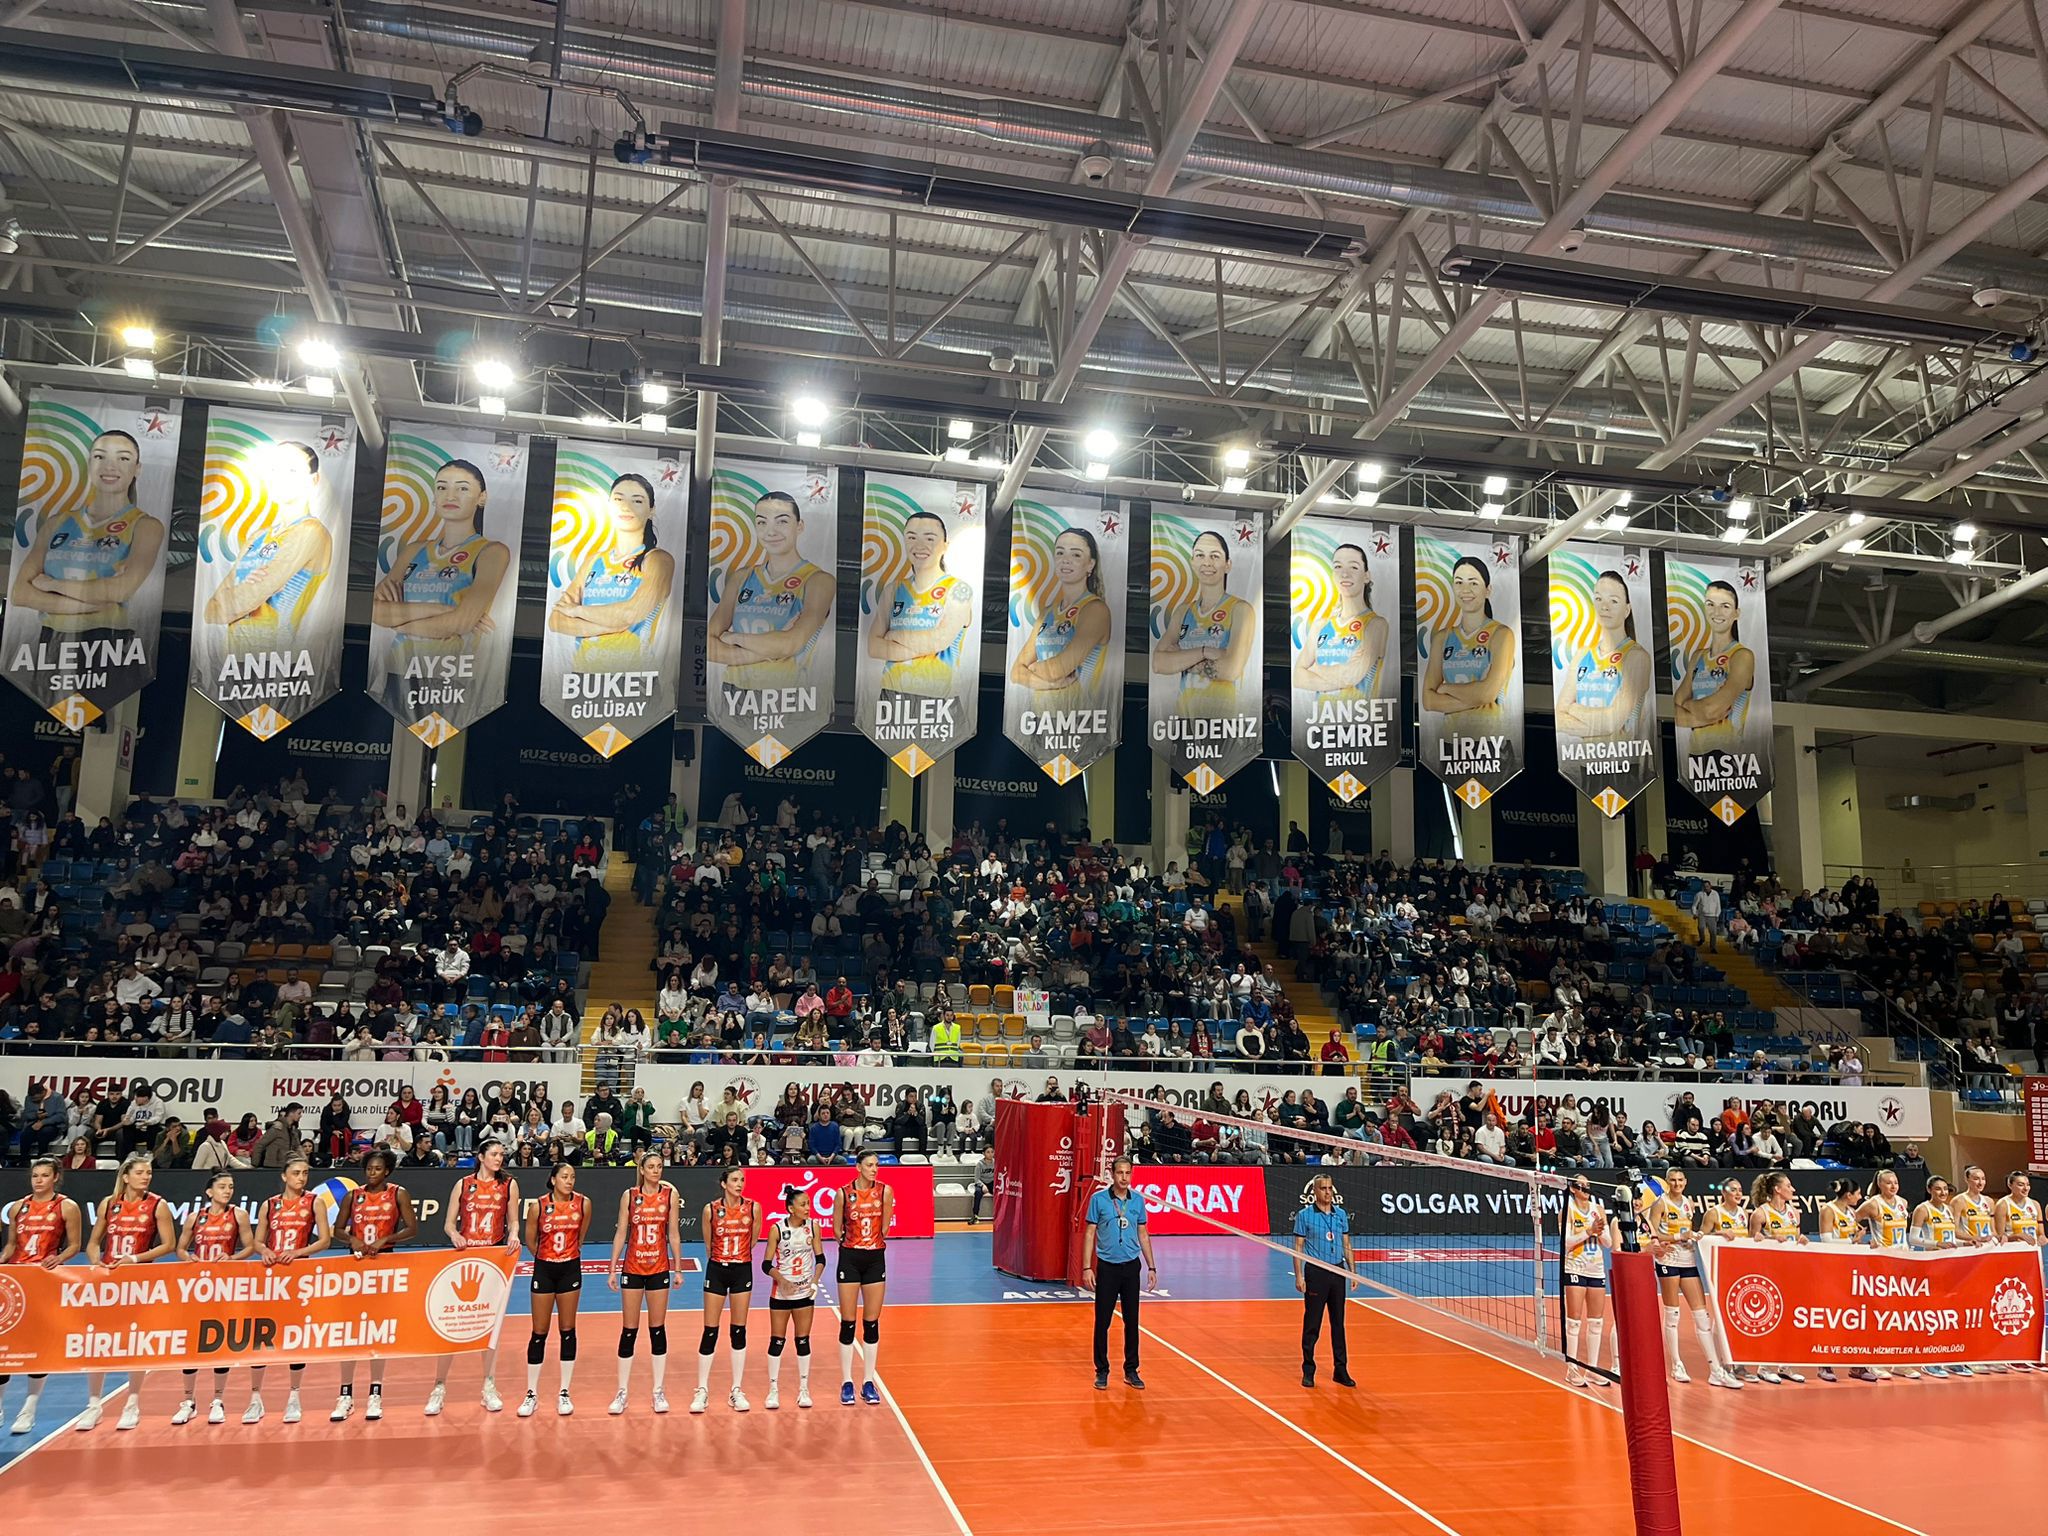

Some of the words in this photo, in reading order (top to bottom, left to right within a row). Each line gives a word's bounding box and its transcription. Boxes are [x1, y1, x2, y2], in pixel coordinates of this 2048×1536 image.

[10, 638, 146, 672] ALEYNA
[218, 650, 315, 682] ANNA
[404, 654, 474, 684] AYŞE
[50, 672, 107, 691] SEVİM
[219, 681, 312, 701] LAZAREVA
[561, 671, 659, 699] BUKET
[407, 687, 464, 709] ÇÜRÜK
[723, 687, 817, 716] YAREN
[65, 694, 85, 730] 5
[571, 701, 647, 719] GÜLÜBAY
[875, 695, 955, 725] DİLEK
[1305, 698, 1397, 725] JANSET
[418, 717, 448, 747] 21
[753, 715, 784, 733] IŞIK
[875, 725, 916, 739] KINIK
[921, 722, 953, 742] EKŞİ
[1020, 710, 1107, 735] GAMZE
[1153, 713, 1257, 741] GÜLDENİZ
[122, 730, 131, 756] B
[287, 738, 392, 755] KUZEYBORU
[599, 726, 615, 757] 7
[1045, 735, 1081, 752] KILIÇ
[1306, 723, 1387, 749] CEMRE
[1439, 732, 1504, 761] LİRAY
[757, 737, 782, 763] 16
[1186, 743, 1223, 759] ÖNAL
[1325, 751, 1368, 767] ERKUL
[1561, 739, 1653, 761] MARGARITA
[744, 764, 836, 781] KUZEYBORU
[906, 747, 917, 776] 1
[1049, 759, 1072, 784] 11
[1445, 760, 1500, 775] AKPINAR
[1586, 760, 1630, 776] KURILO
[1689, 753, 1761, 780] NASYA
[1194, 766, 1215, 794] 10
[1337, 773, 1358, 800] 13
[1694, 776, 1758, 793] DIMITROVA
[1467, 781, 1481, 806] 8
[1601, 789, 1619, 816] 17
[1500, 810, 1576, 824] KUZEYBORU
[1721, 802, 1734, 826] 6
[272, 1078, 404, 1099] KUZEYBORU
[1131, 1184, 1245, 1213] SARAY
[1381, 1193, 1480, 1215] SOLGAR
[470, 1211, 494, 1233] 14
[860, 1217, 872, 1237] 3
[1976, 1222, 1990, 1238] 14
[24, 1234, 39, 1256] 4
[275, 1228, 298, 1251] 12
[363, 1223, 378, 1245] 8
[553, 1232, 565, 1253] 9
[637, 1224, 659, 1245] 15
[1892, 1228, 1904, 1244] 17
[111, 1234, 135, 1259] 16
[722, 1236, 740, 1257] 11
[791, 1257, 803, 1276] 2
[1661, 1265, 1668, 1274] 6
[60, 1280, 170, 1307] KADINA
[177, 1267, 292, 1303] YÖNELİK
[297, 1265, 409, 1307] ŞİDDETE
[1570, 1274, 1579, 1283] 10
[1852, 1269, 1931, 1297] İNSANA
[443, 1304, 455, 1313] 25
[458, 1302, 490, 1313] KASIM
[1792, 1304, 1867, 1331] SEVGİ
[1873, 1309, 1959, 1336] YAKIŞIR
[1965, 1308, 1984, 1329] !!!
[65, 1322, 188, 1359] BİRLİKTE
[197, 1317, 277, 1353] DUR
[282, 1312, 397, 1350] DİYELİM!
[1811, 1345, 1829, 1354] AİLE
[1830, 1346, 1841, 1354] VE
[1842, 1346, 1872, 1354] SOSYAL
[1873, 1345, 1914, 1354] HİZMETLER
[1914, 1344, 1922, 1354] İL
